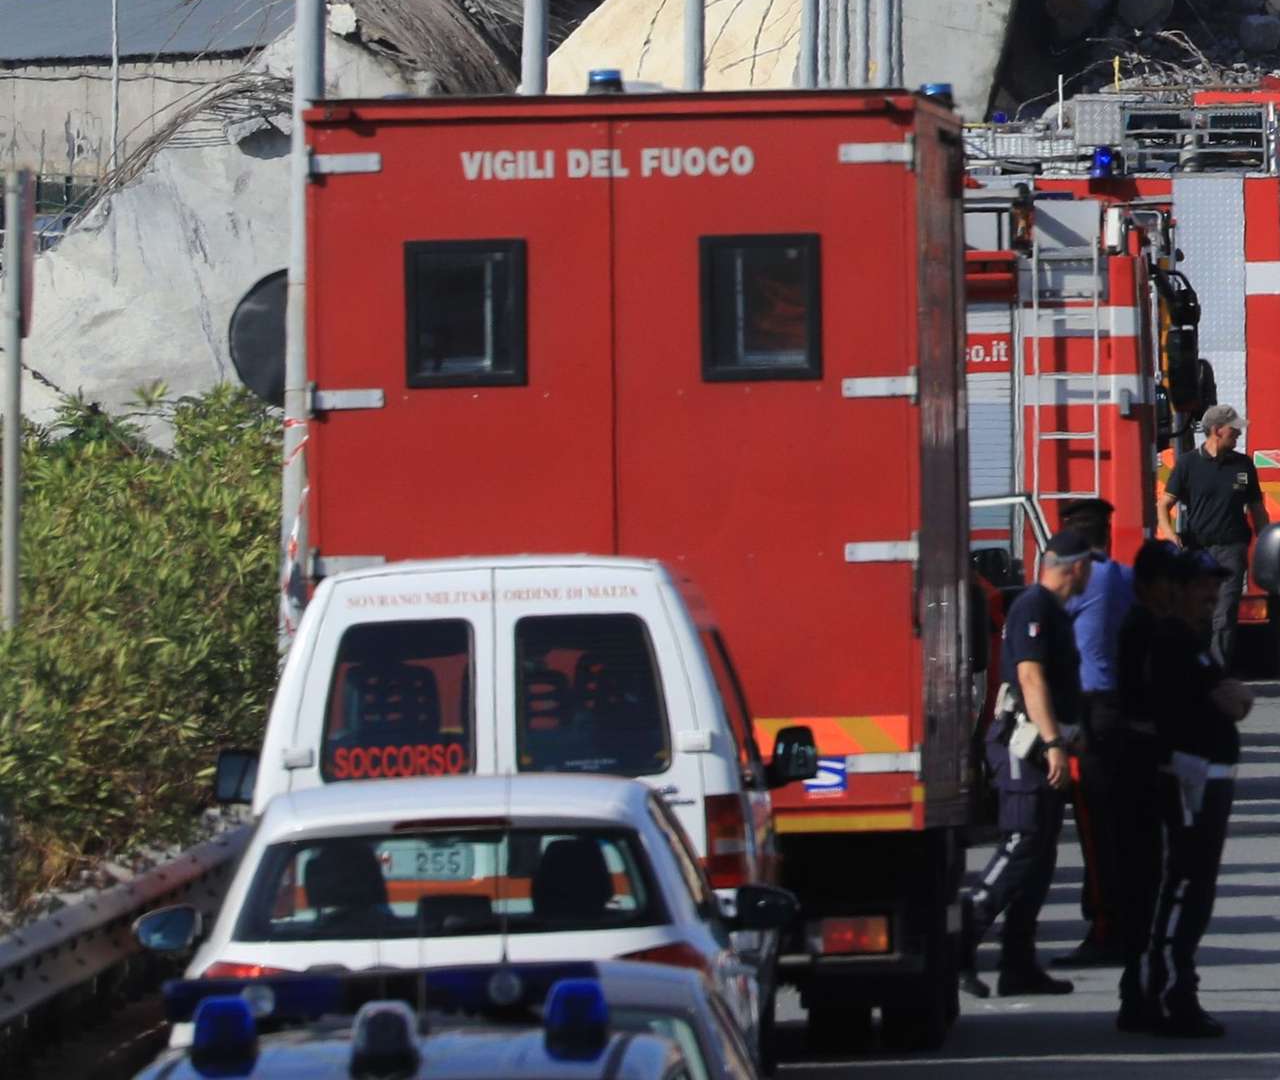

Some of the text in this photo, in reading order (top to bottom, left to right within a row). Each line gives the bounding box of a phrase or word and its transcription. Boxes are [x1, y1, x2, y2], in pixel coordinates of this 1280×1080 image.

[460, 146, 755, 180] VIGILI DEL FUOCO
[334, 744, 465, 779] SOCCORSO
[415, 851, 462, 874] 255
